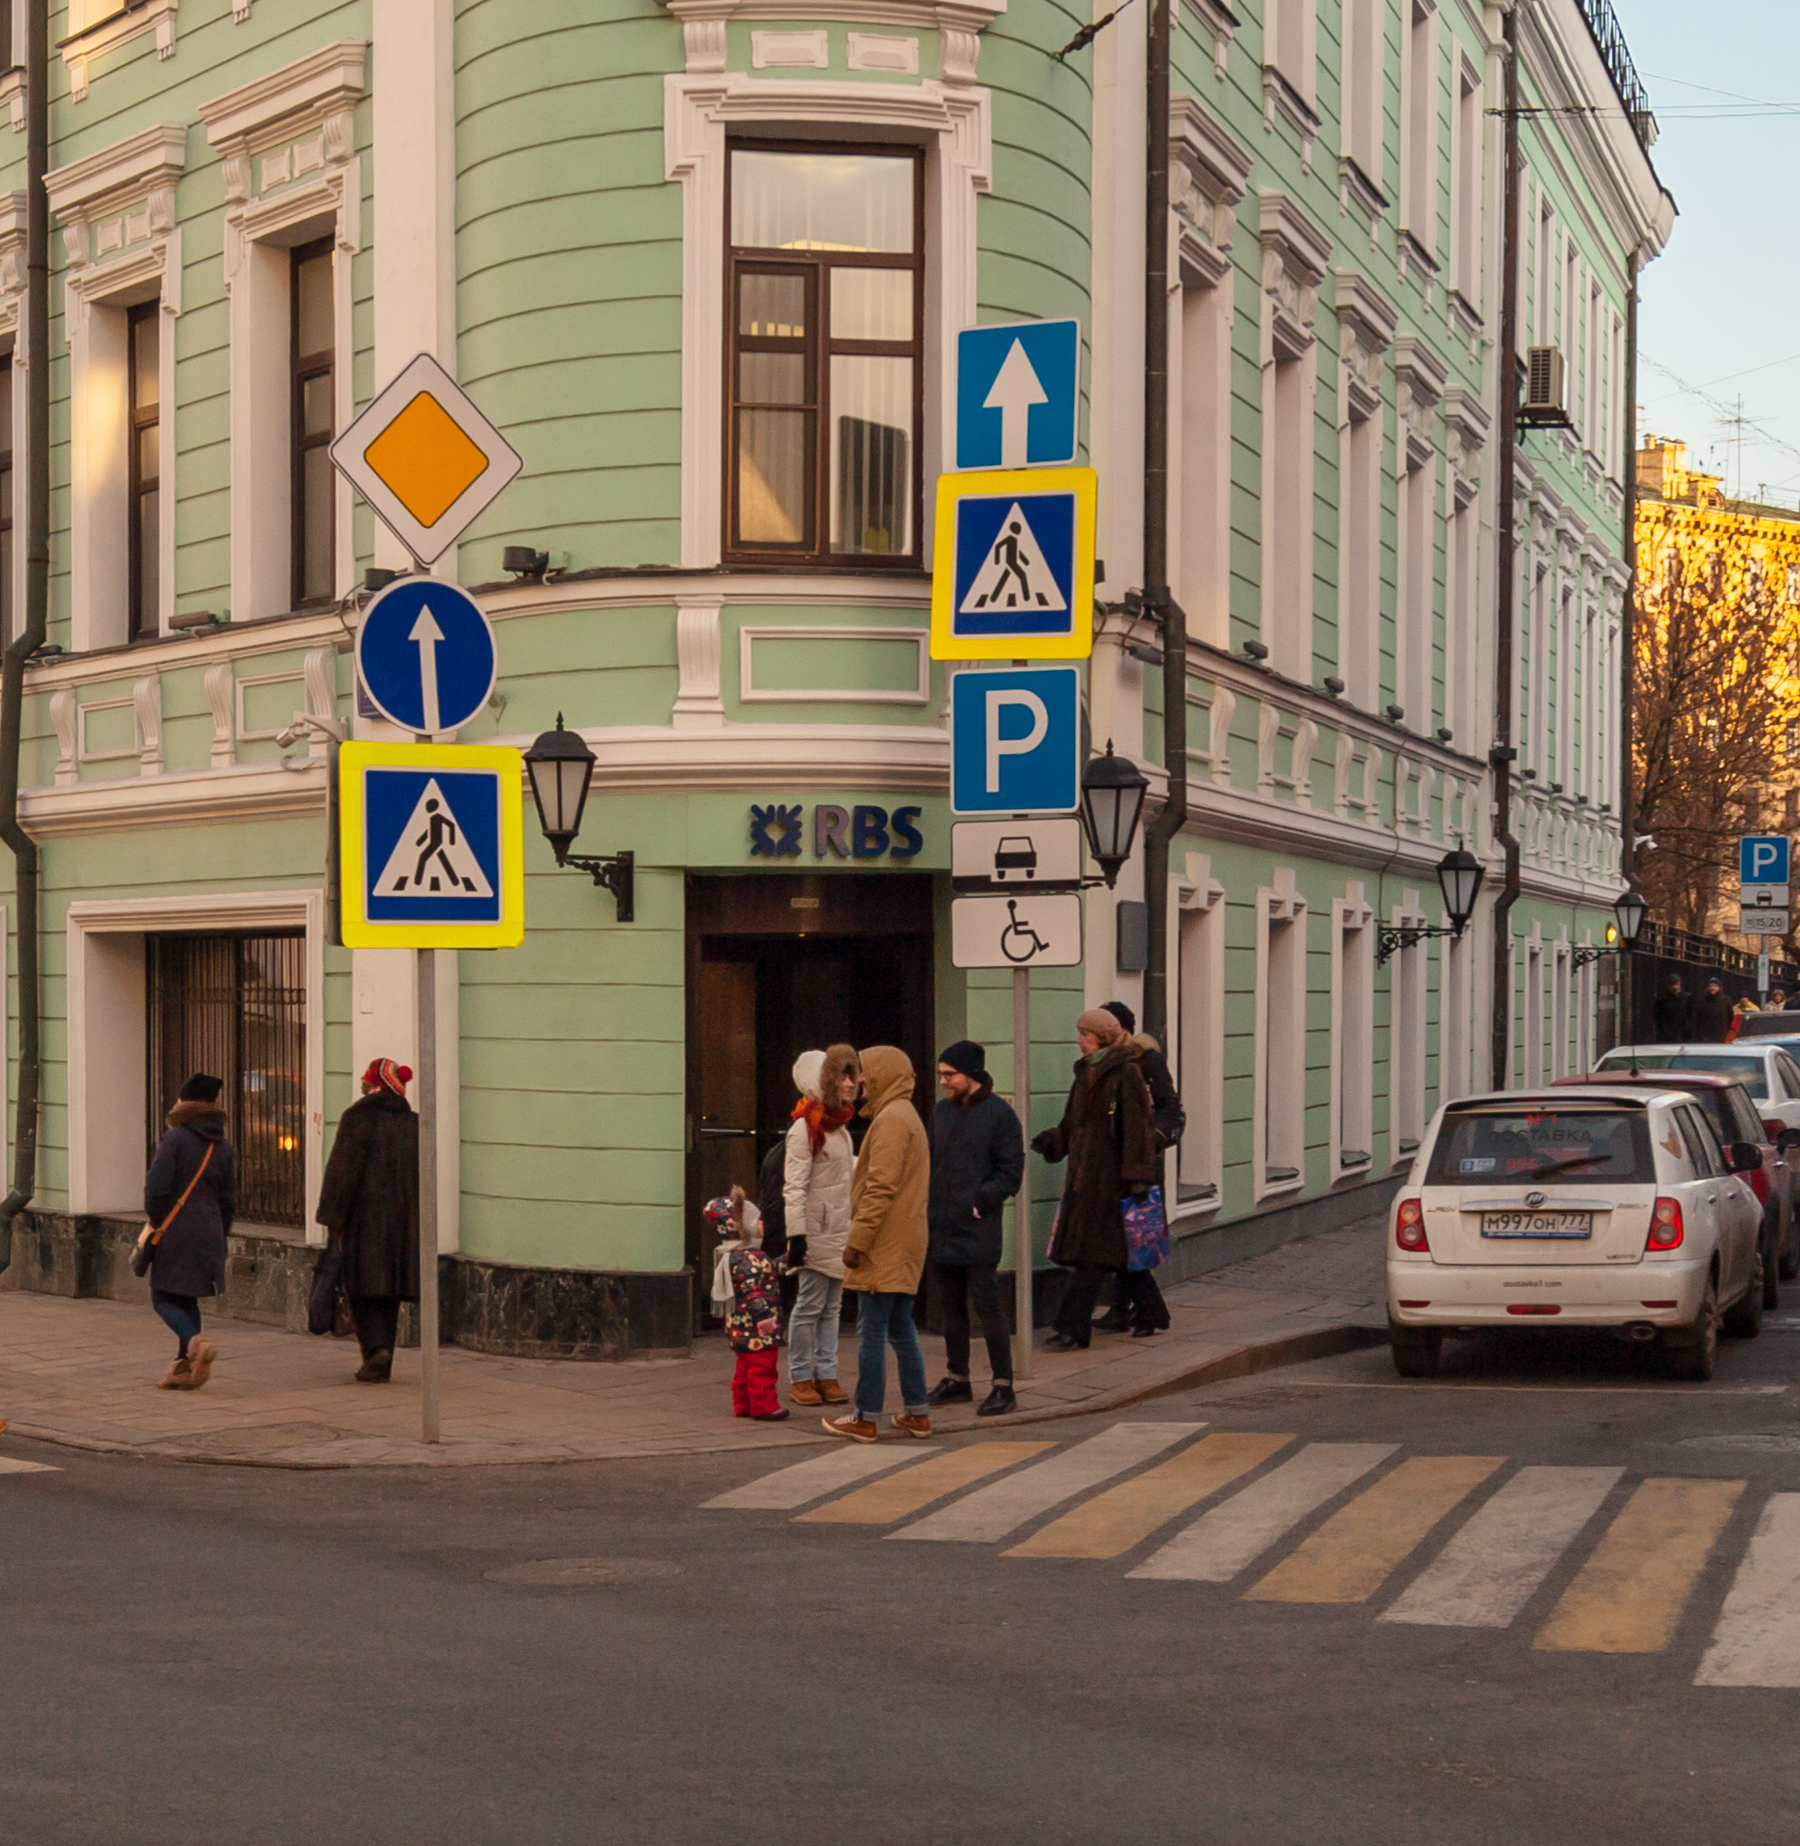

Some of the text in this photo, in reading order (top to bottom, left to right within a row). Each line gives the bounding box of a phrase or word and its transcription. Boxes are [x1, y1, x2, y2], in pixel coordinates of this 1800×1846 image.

[985, 689, 1049, 793] P
[813, 804, 924, 858] RBS
[1753, 843, 1778, 878] P
[1768, 917, 1783, 928] 20
[1488, 1128, 1594, 1144] ДОСТАВКА
[1488, 1212, 1586, 1230] М997ОН 777
